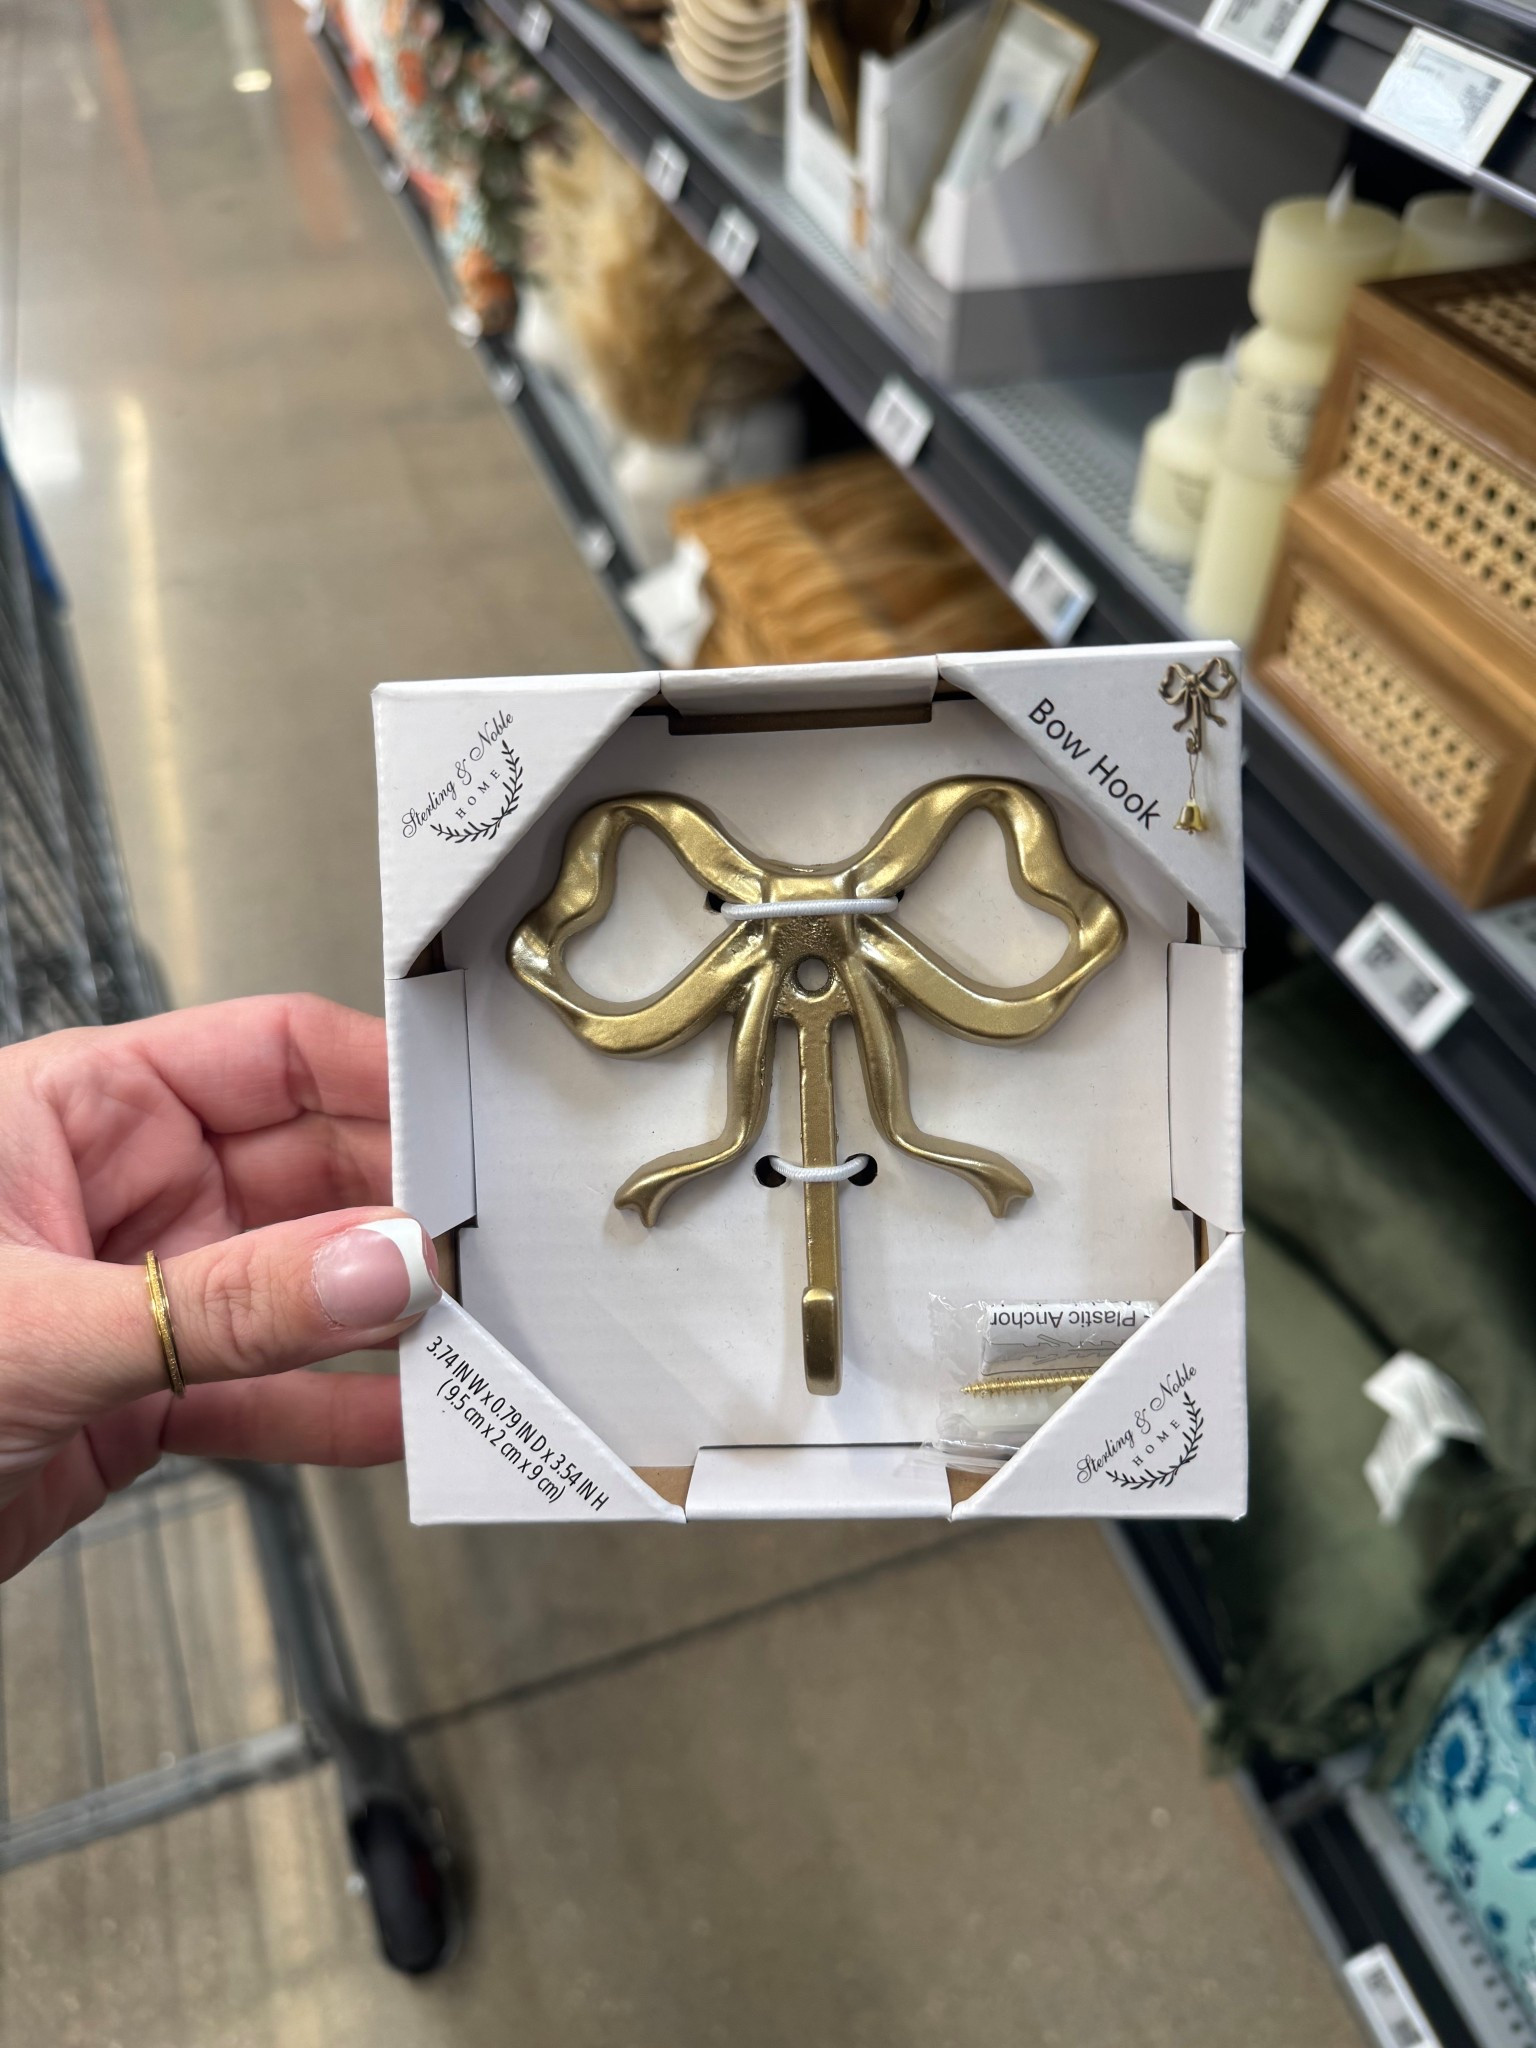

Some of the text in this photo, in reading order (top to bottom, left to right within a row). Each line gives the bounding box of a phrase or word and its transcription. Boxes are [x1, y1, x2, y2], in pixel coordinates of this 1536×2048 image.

[401, 710, 514, 838] Sterling & Noble
[455, 769, 501, 820] HOME
[1028, 697, 1161, 831] Bow Hook
[990, 1310, 1136, 1329] Plastic Anchor
[426, 1335, 610, 1512] 3.74 IN W x 0.79 IN D x 3.54 IN H
[464, 1407, 486, 1430] cm
[480, 1423, 495, 1439] x
[489, 1429, 506, 1447] 2
[500, 1442, 522, 1465] cm
[517, 1459, 532, 1474] x
[527, 1465, 544, 1481] 9
[537, 1477, 566, 1504] cm)
[1076, 1363, 1197, 1484] Sterling & Noble
[1132, 1419, 1180, 1467] HOME
